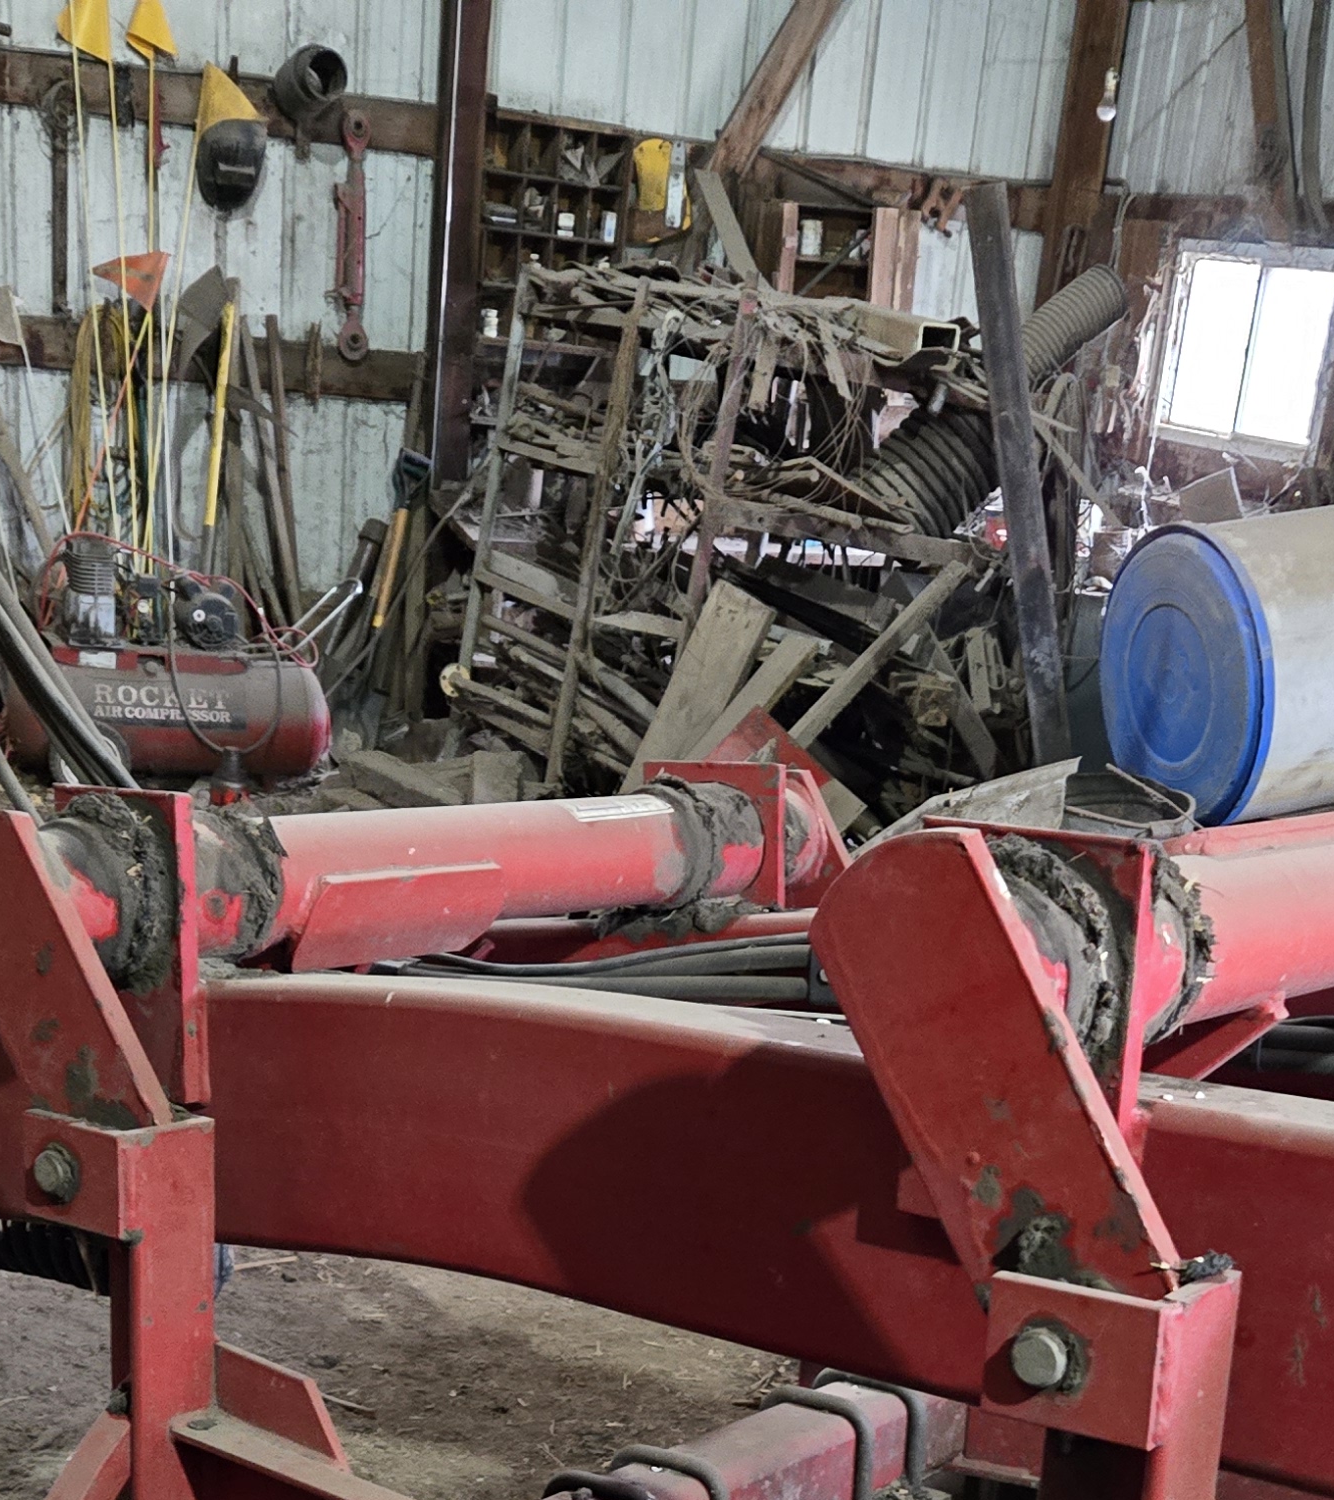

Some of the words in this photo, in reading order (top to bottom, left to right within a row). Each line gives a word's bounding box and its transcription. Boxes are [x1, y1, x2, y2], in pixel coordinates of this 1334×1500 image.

[94, 684, 232, 709] ROCKET
[94, 705, 123, 718] AIR
[124, 706, 231, 723] COMPRSSOR
